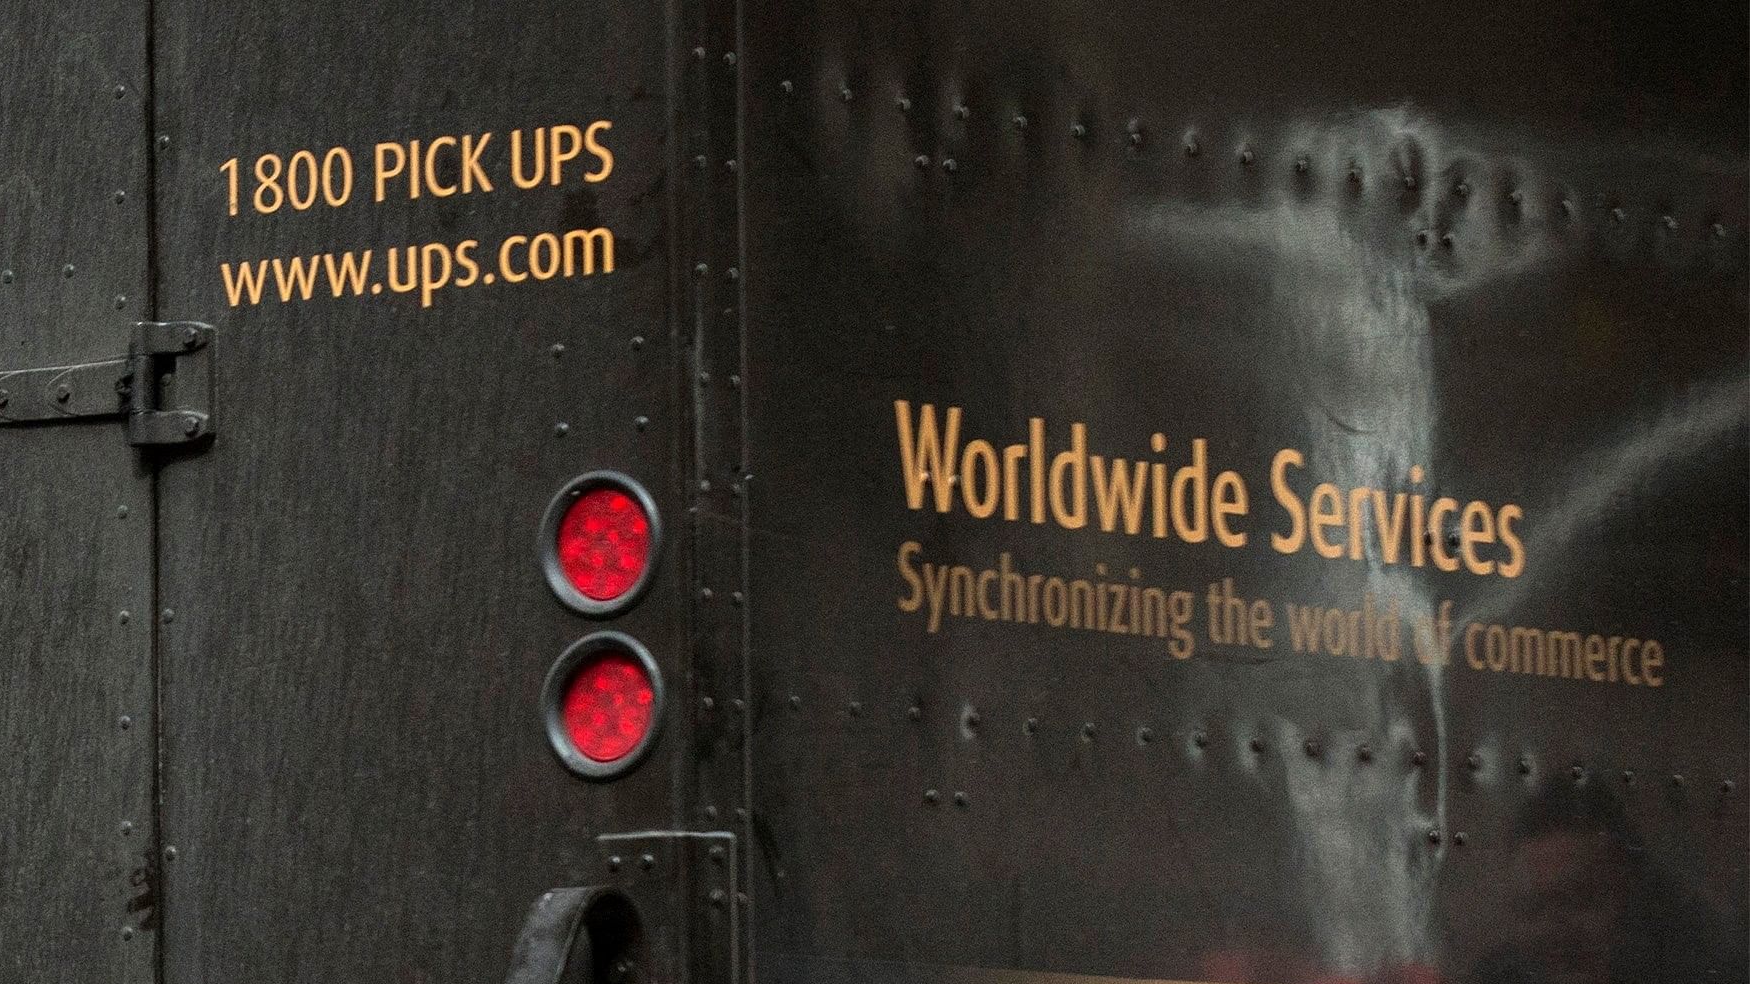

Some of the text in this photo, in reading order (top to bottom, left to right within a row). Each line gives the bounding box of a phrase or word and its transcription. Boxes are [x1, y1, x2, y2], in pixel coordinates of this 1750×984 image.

[221, 119, 615, 217] 1800 PICK UPS
[220, 226, 616, 308] www.ups.com
[895, 399, 1525, 579] Worldwide Services
[896, 541, 1664, 688] Synchronizing the world of commerce
